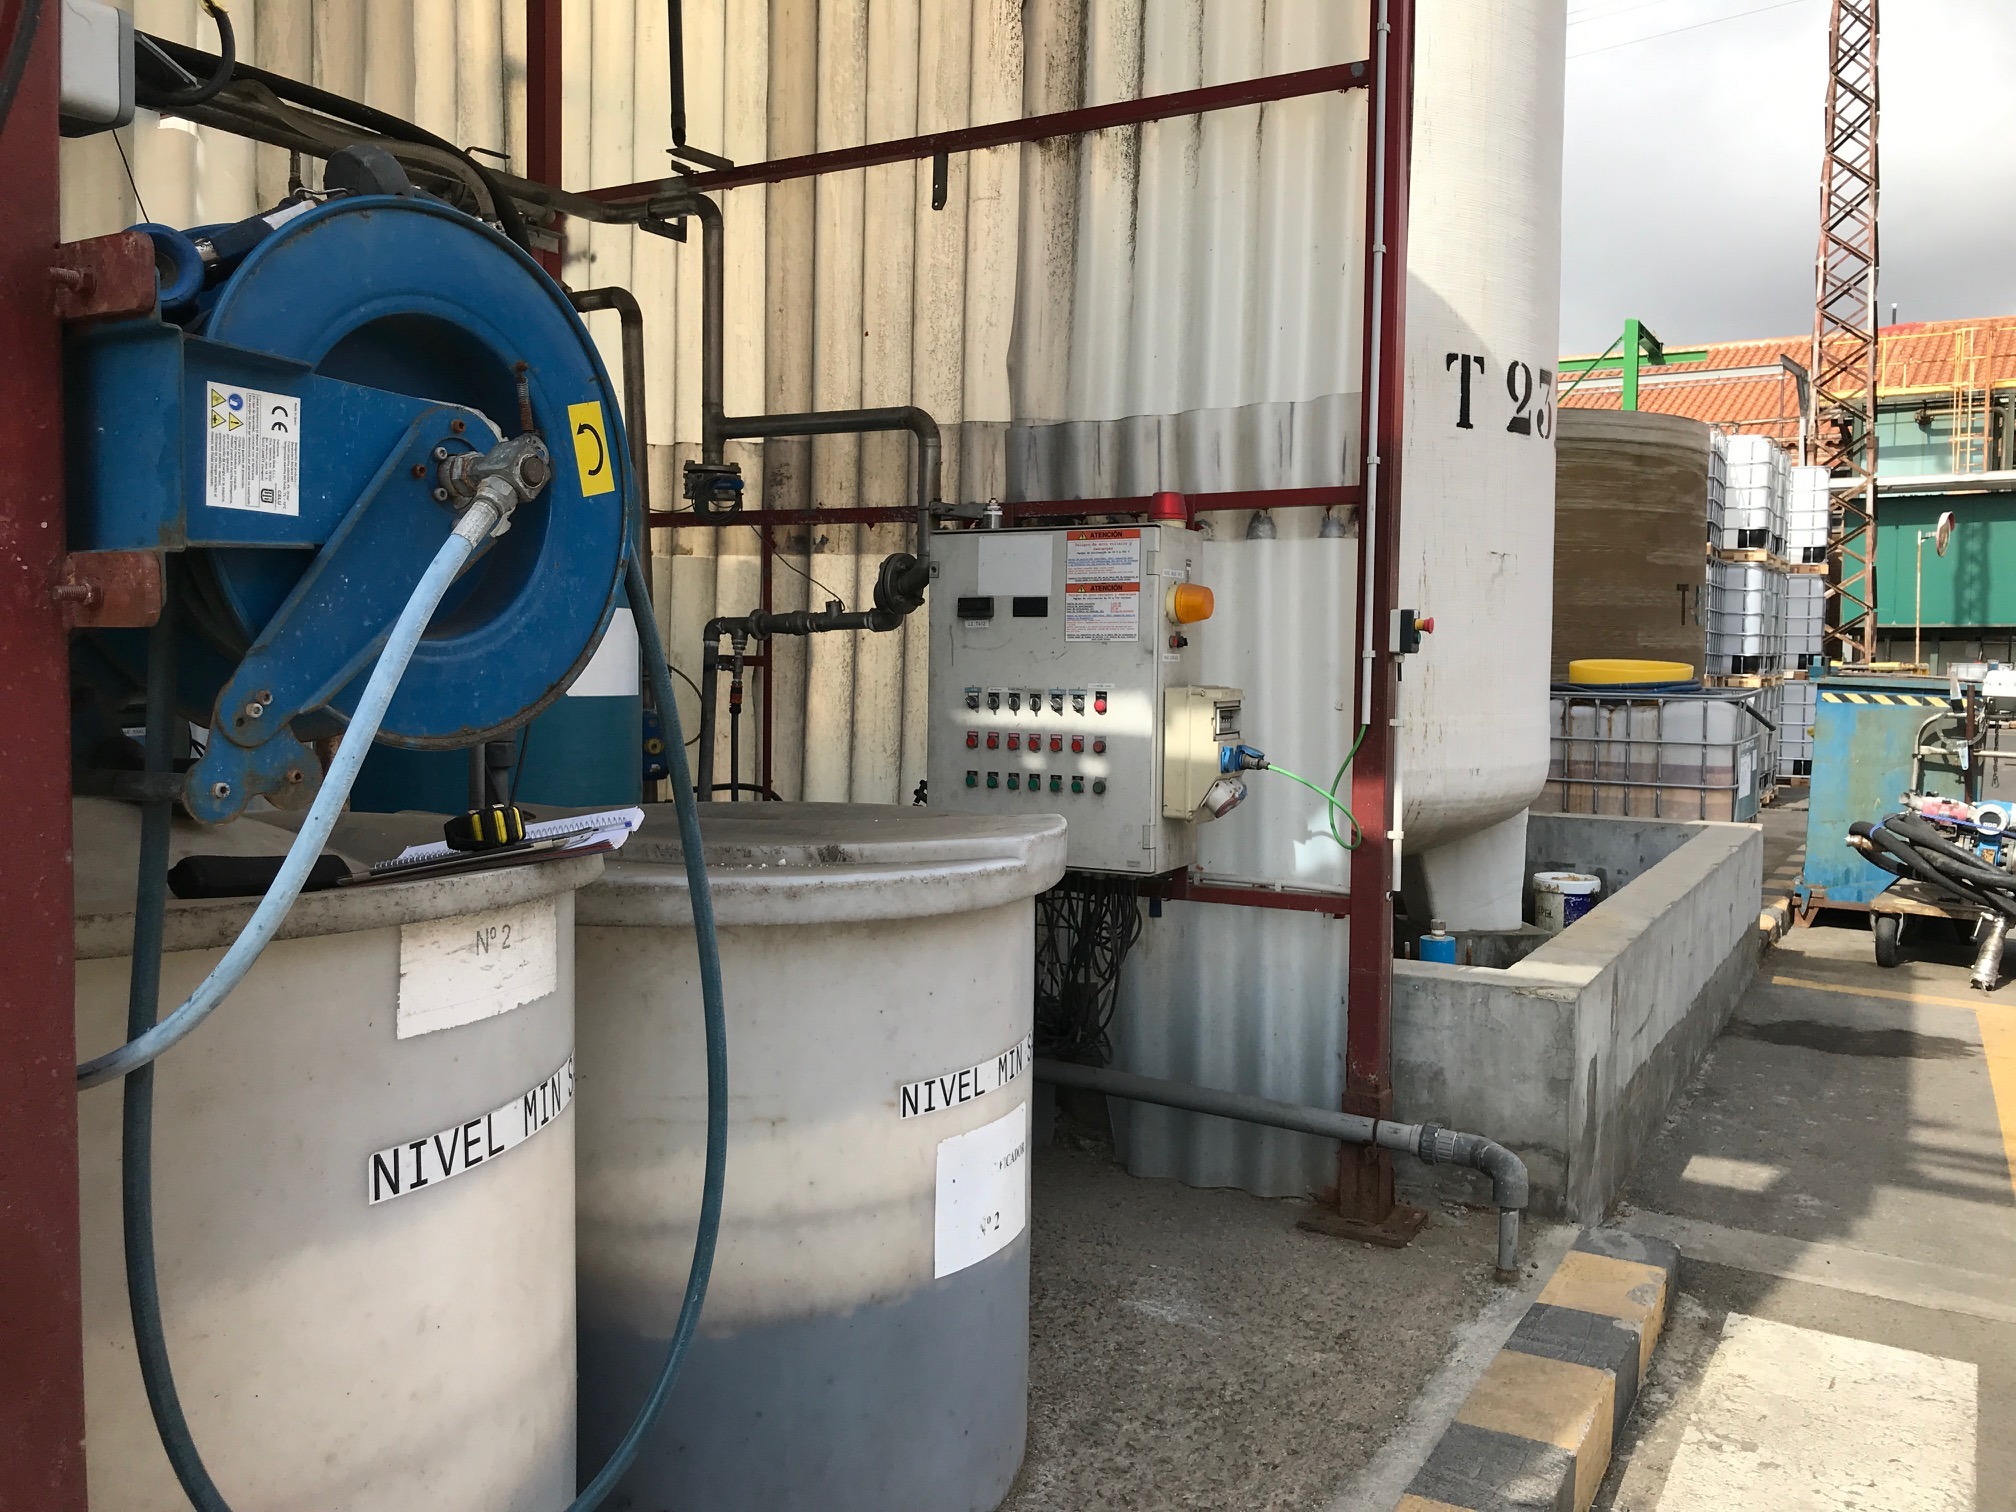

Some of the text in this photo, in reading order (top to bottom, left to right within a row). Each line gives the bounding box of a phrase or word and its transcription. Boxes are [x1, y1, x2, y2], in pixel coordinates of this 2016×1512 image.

[1446, 353, 1553, 440] T 23
[501, 924, 511, 950] 2
[902, 1033, 1034, 1118] NIVEL MIN S
[373, 1056, 575, 1202] NIVEL MIN S
[993, 1210, 1000, 1231] 2
